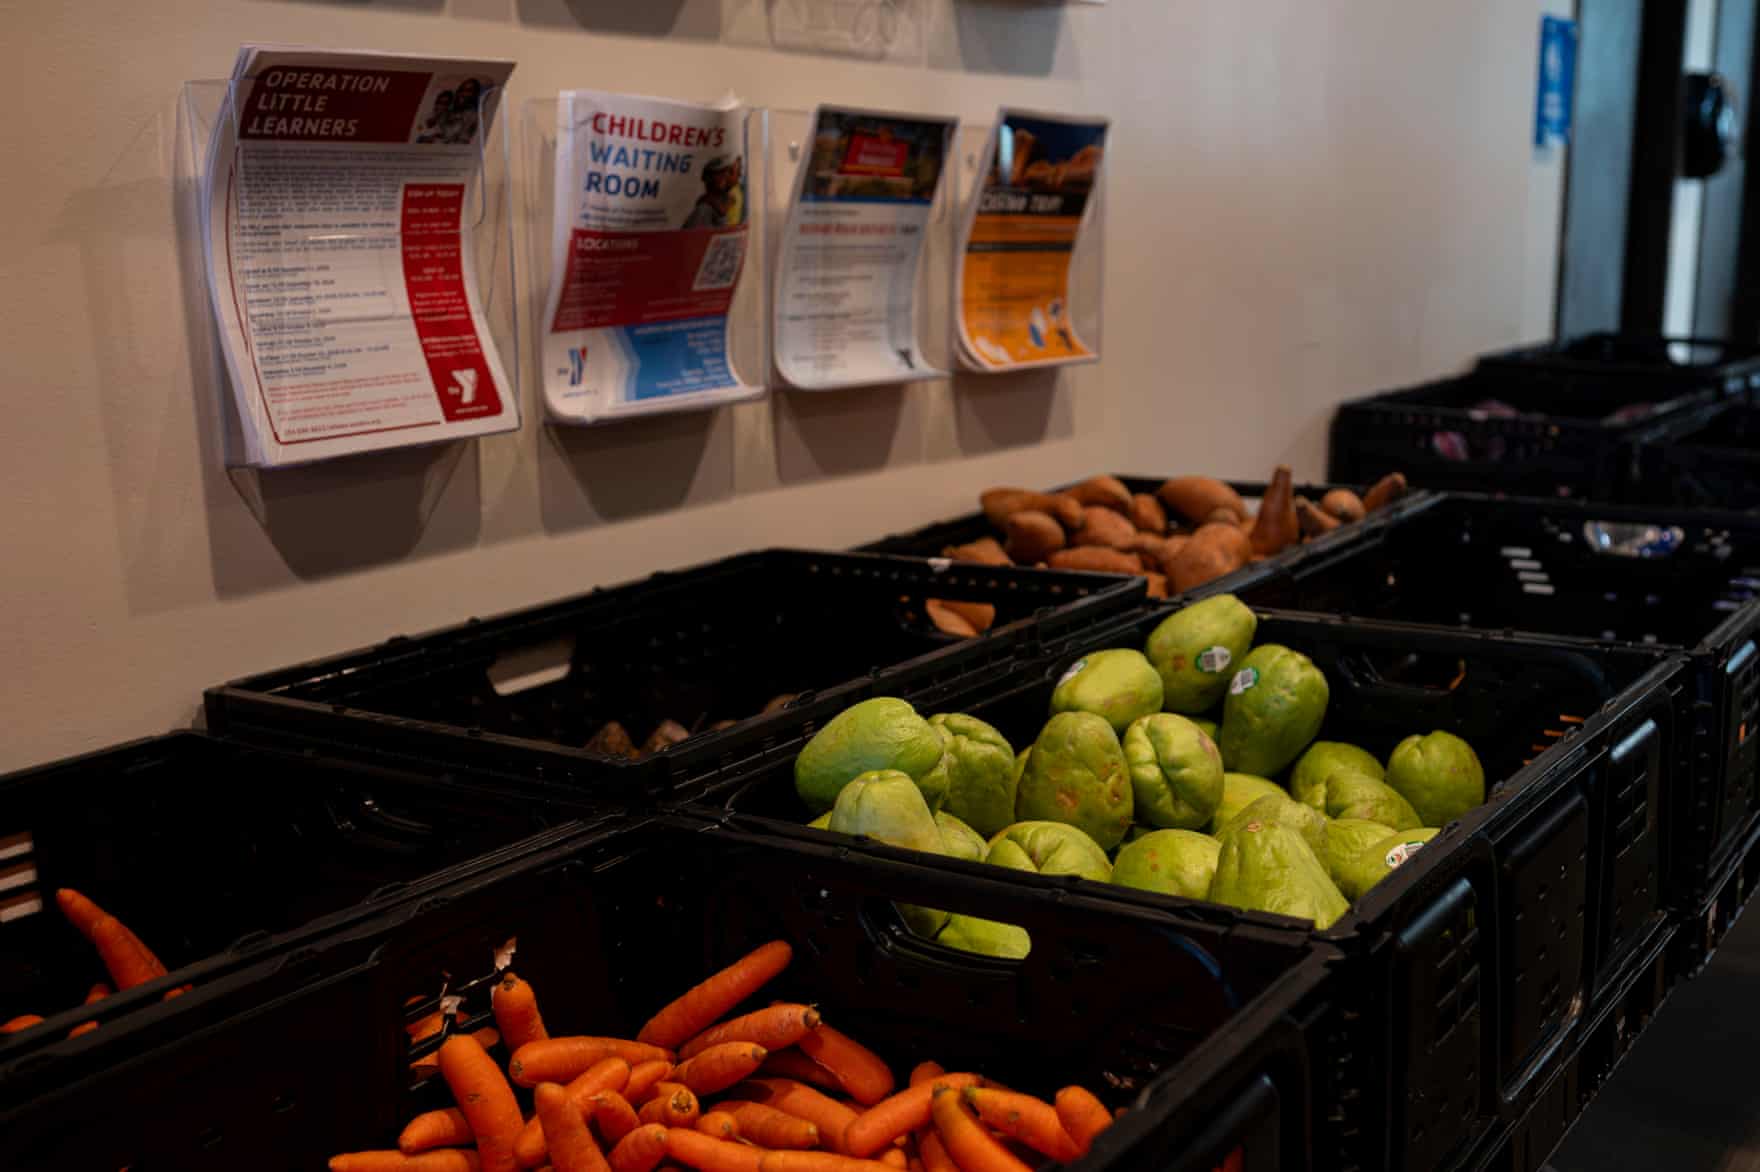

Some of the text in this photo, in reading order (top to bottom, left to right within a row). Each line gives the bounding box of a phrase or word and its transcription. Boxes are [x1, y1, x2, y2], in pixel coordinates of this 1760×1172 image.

[265, 72, 390, 92] OPERATION
[257, 94, 328, 112] LITTLE
[247, 117, 359, 137] LEARNERS
[592, 112, 726, 148] CHILDREN'S
[588, 142, 694, 173] WAITING
[584, 171, 661, 199] ROOM
